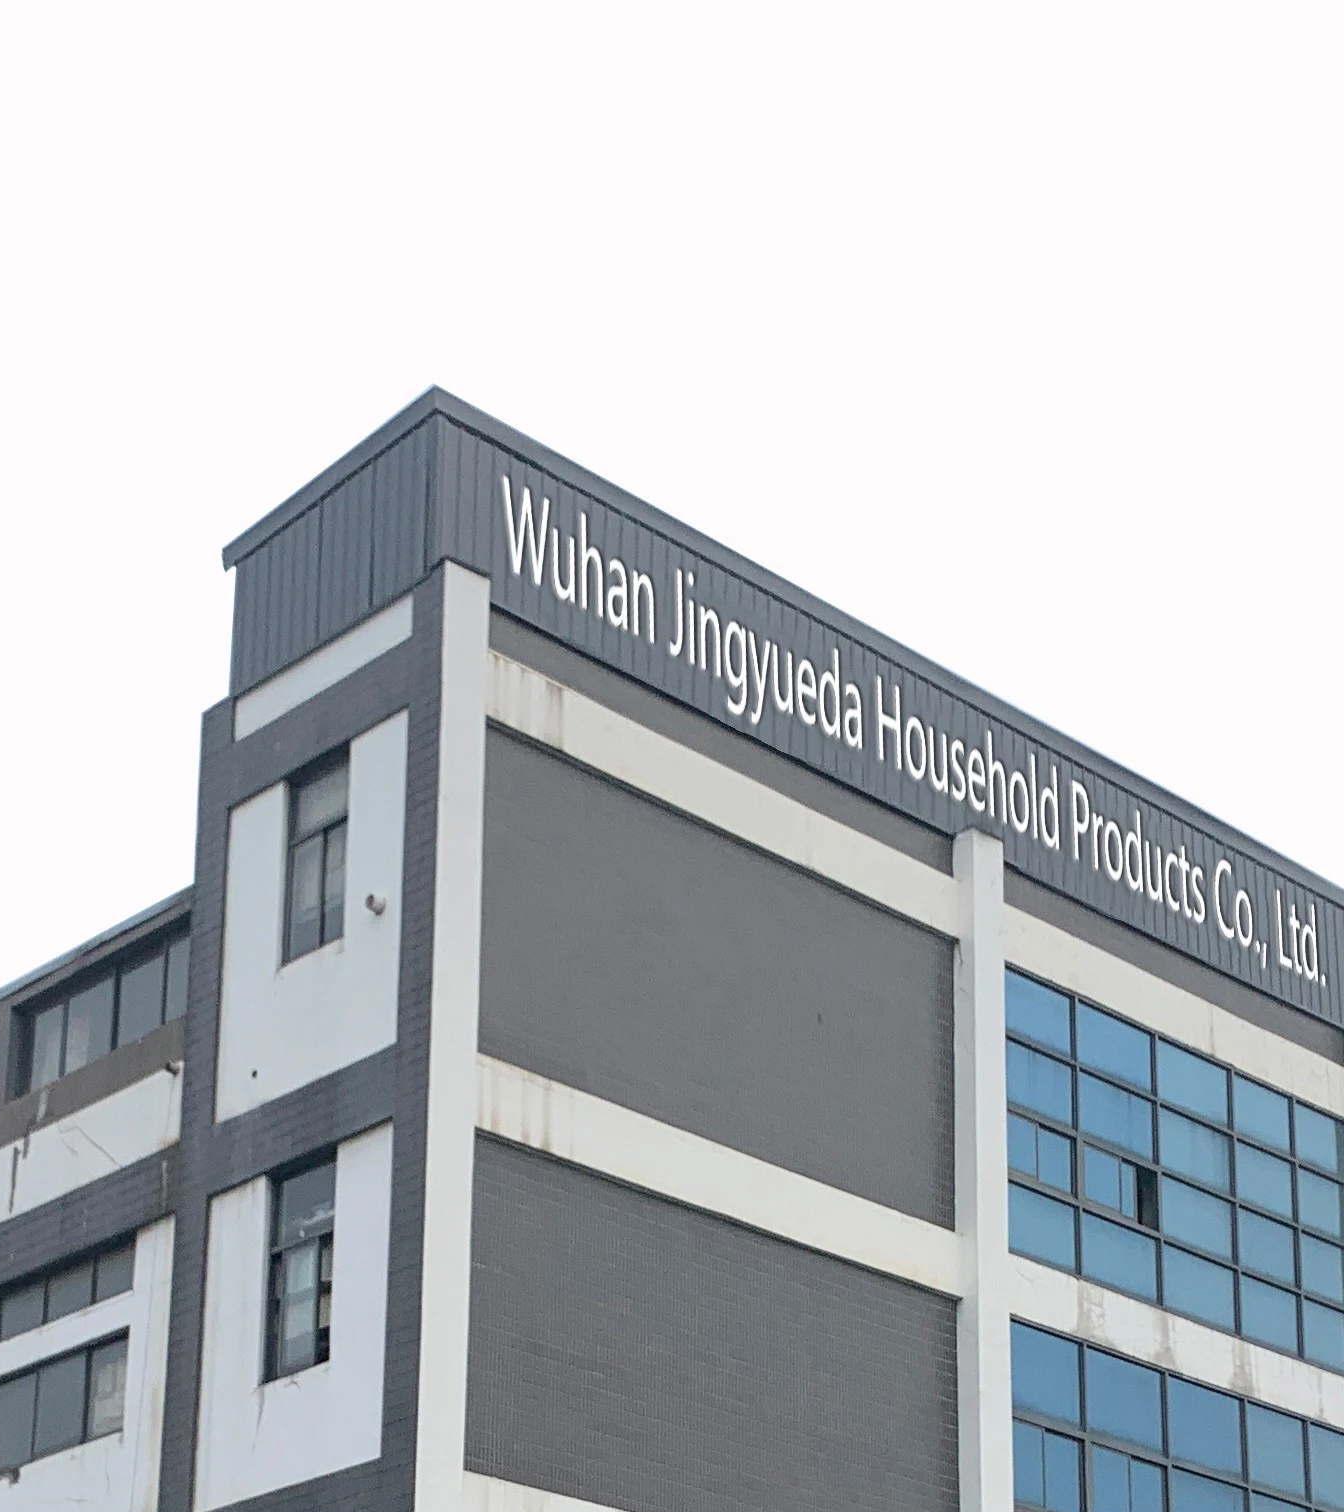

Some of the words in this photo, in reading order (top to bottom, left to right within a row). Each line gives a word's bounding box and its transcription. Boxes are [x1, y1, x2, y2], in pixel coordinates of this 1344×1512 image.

[503, 475, 655, 644] Wuhan
[669, 568, 863, 750] Jingyueda
[876, 675, 1060, 850] Household
[1071, 780, 1206, 924] Products
[1214, 859, 1268, 969] Co.,
[1276, 889, 1327, 987] Ltd.
